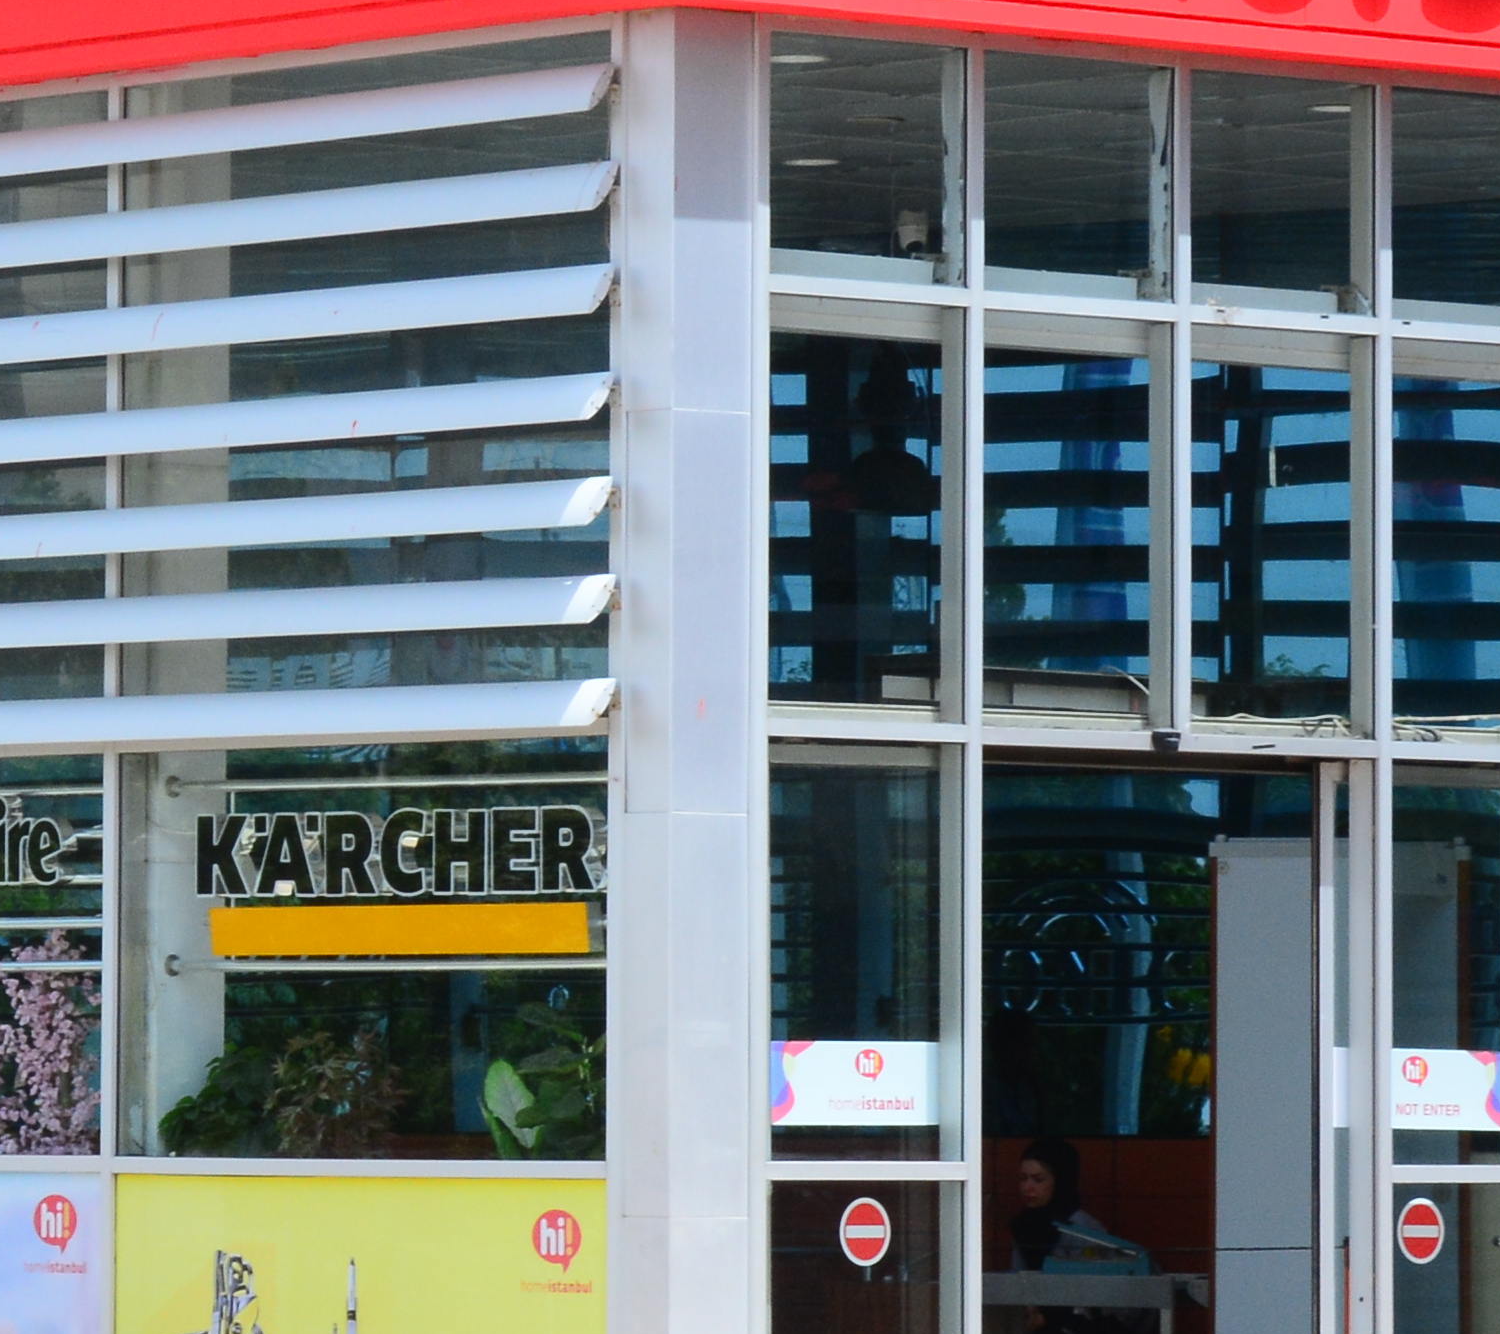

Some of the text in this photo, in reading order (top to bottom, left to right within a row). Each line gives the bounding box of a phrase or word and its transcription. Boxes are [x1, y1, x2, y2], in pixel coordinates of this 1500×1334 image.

[195, 805, 598, 898] KÄRCHER
[859, 1052, 880, 1075] hi!
[1406, 1059, 1426, 1081] hi!
[829, 1096, 915, 1110] homeistanbul
[1396, 1104, 1460, 1116] NOT ENTER
[39, 1201, 71, 1240] hi!
[540, 1216, 573, 1257] hi!
[521, 1279, 593, 1294] homeistanbul
